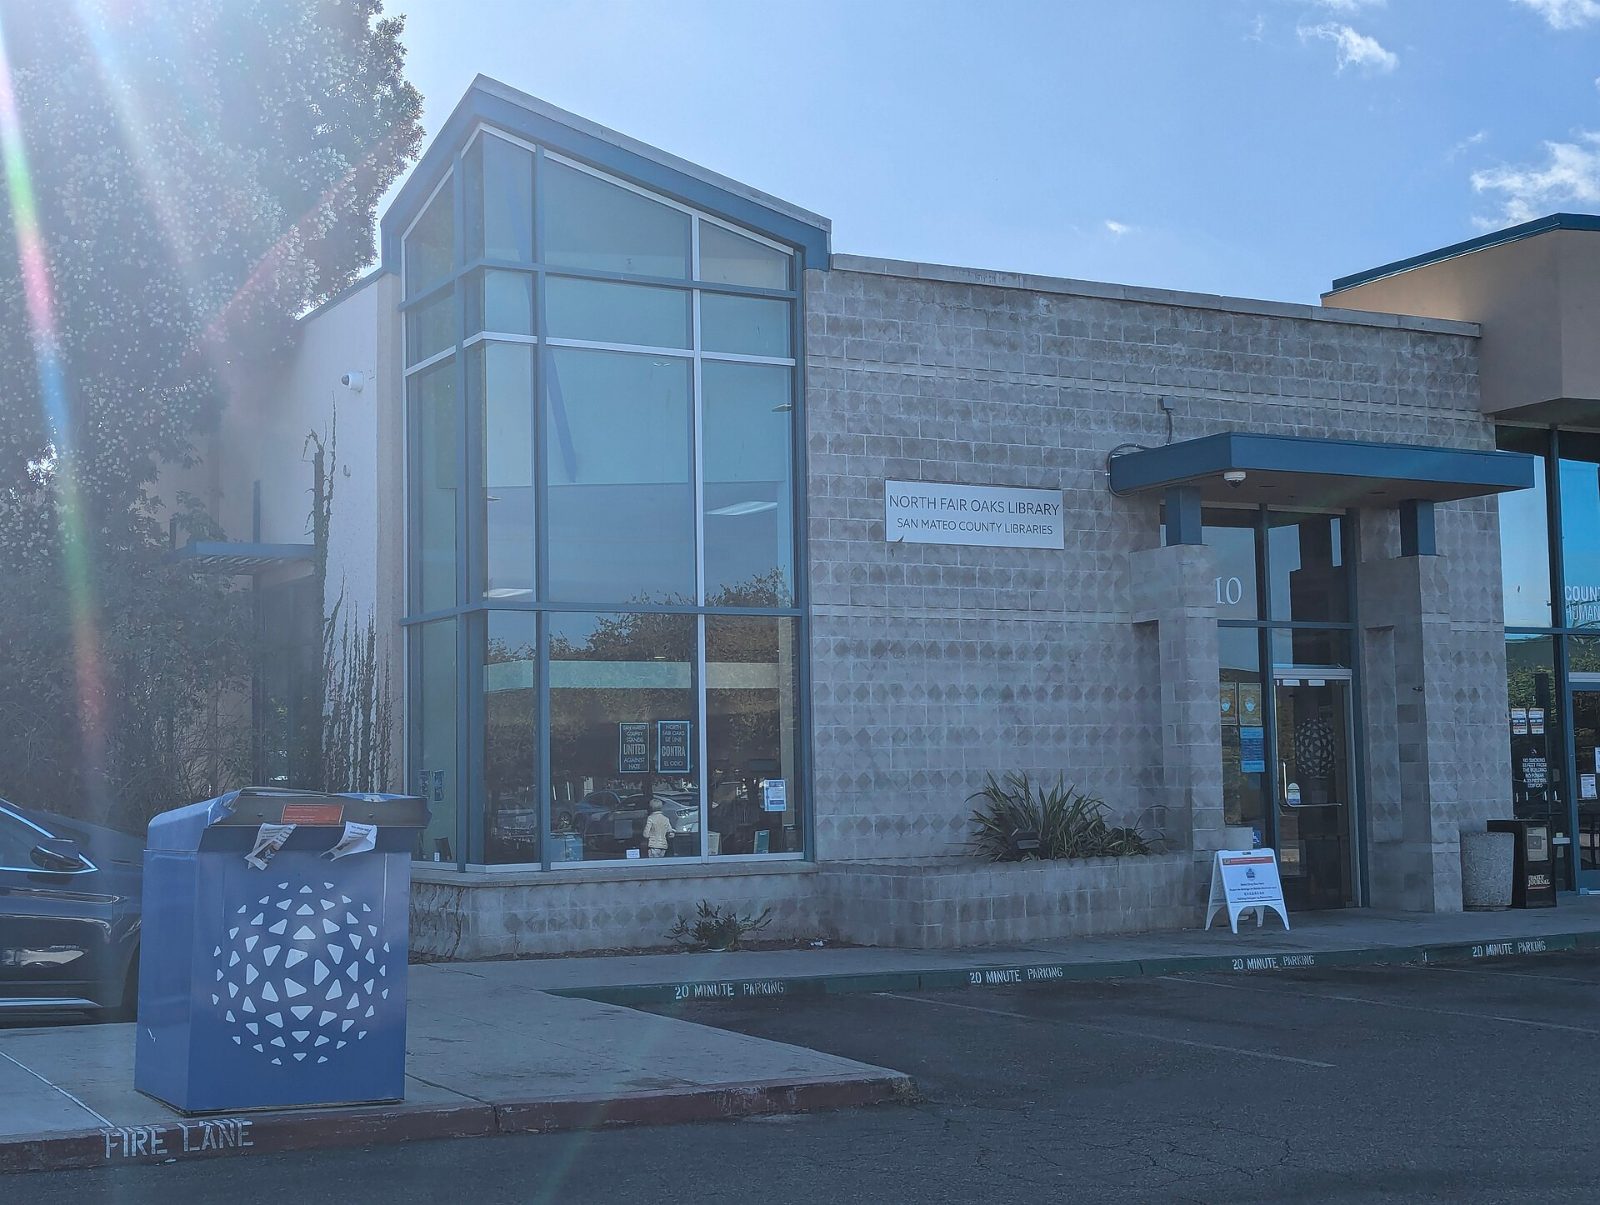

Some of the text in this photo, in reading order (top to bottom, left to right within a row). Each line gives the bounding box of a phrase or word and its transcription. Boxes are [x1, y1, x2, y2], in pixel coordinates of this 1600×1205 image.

[889, 494, 1060, 516] NORTH FAIR OAKS LIBRARY
[897, 517, 1054, 535] SAN MATEO COUNTY LIBRARIES
[1215, 576, 1243, 605] 10
[623, 743, 646, 755] UNITED
[661, 745, 686, 757] CONTRA
[1472, 940, 1546, 957] 20 MINUTE PARKING
[1232, 955, 1315, 970] 20 MINUTE PARKING
[969, 967, 1063, 984] 20 MINUTE PARKING
[675, 980, 784, 999] 20 MINUTE PARKING
[99, 1118, 254, 1159] FIRE LANE
